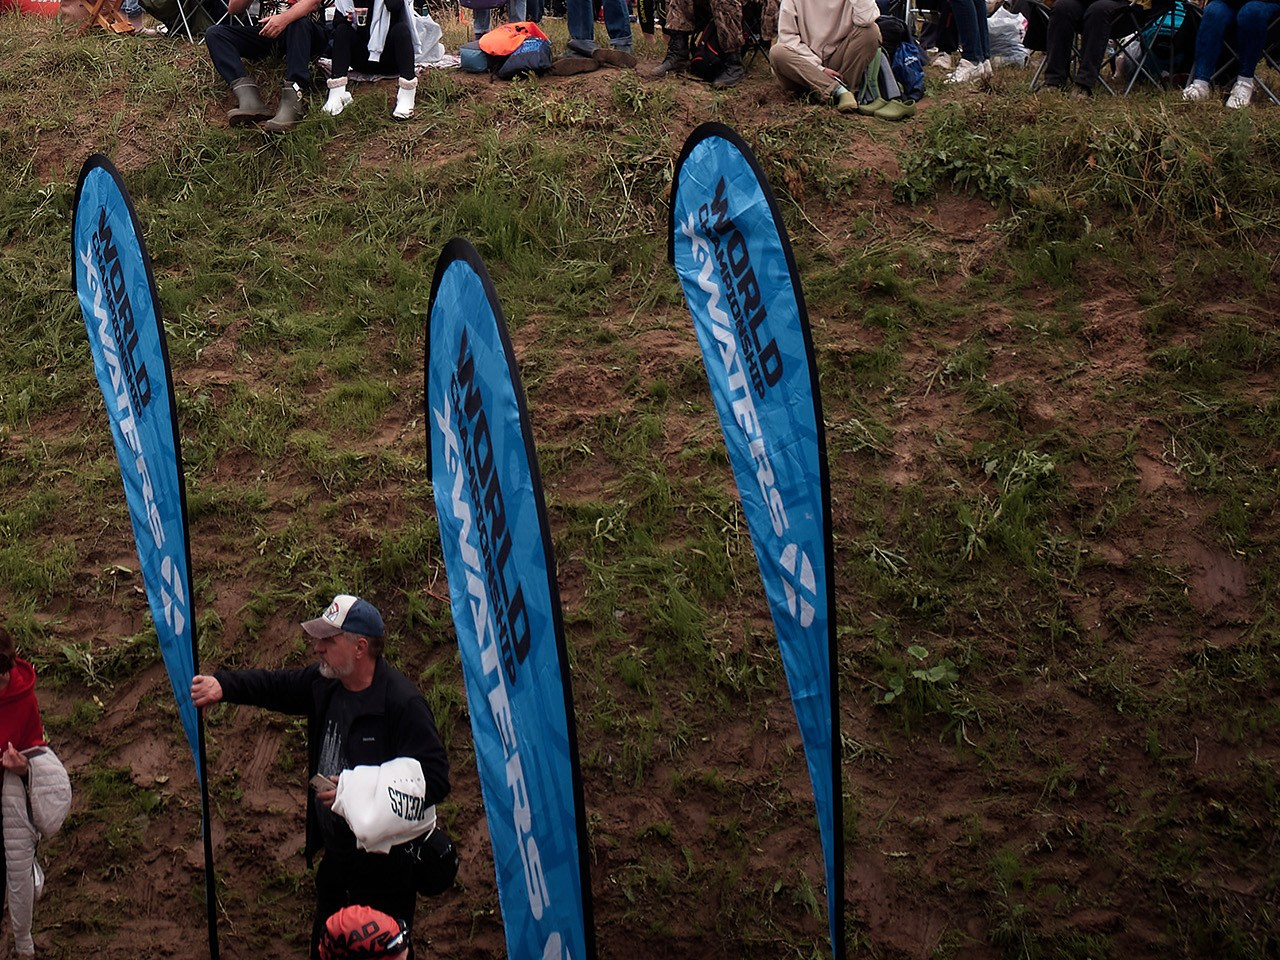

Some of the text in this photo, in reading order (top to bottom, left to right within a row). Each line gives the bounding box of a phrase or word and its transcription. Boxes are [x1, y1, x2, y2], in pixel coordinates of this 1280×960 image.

[92, 231, 142, 418] CHAMPIONSHIP
[98, 206, 151, 408] WORLD
[698, 203, 765, 400] CHAMPIONSHIP
[711, 176, 784, 388] WORLD
[451, 372, 516, 686] CHAMPIONSHIP
[457, 325, 531, 666] WORLD
